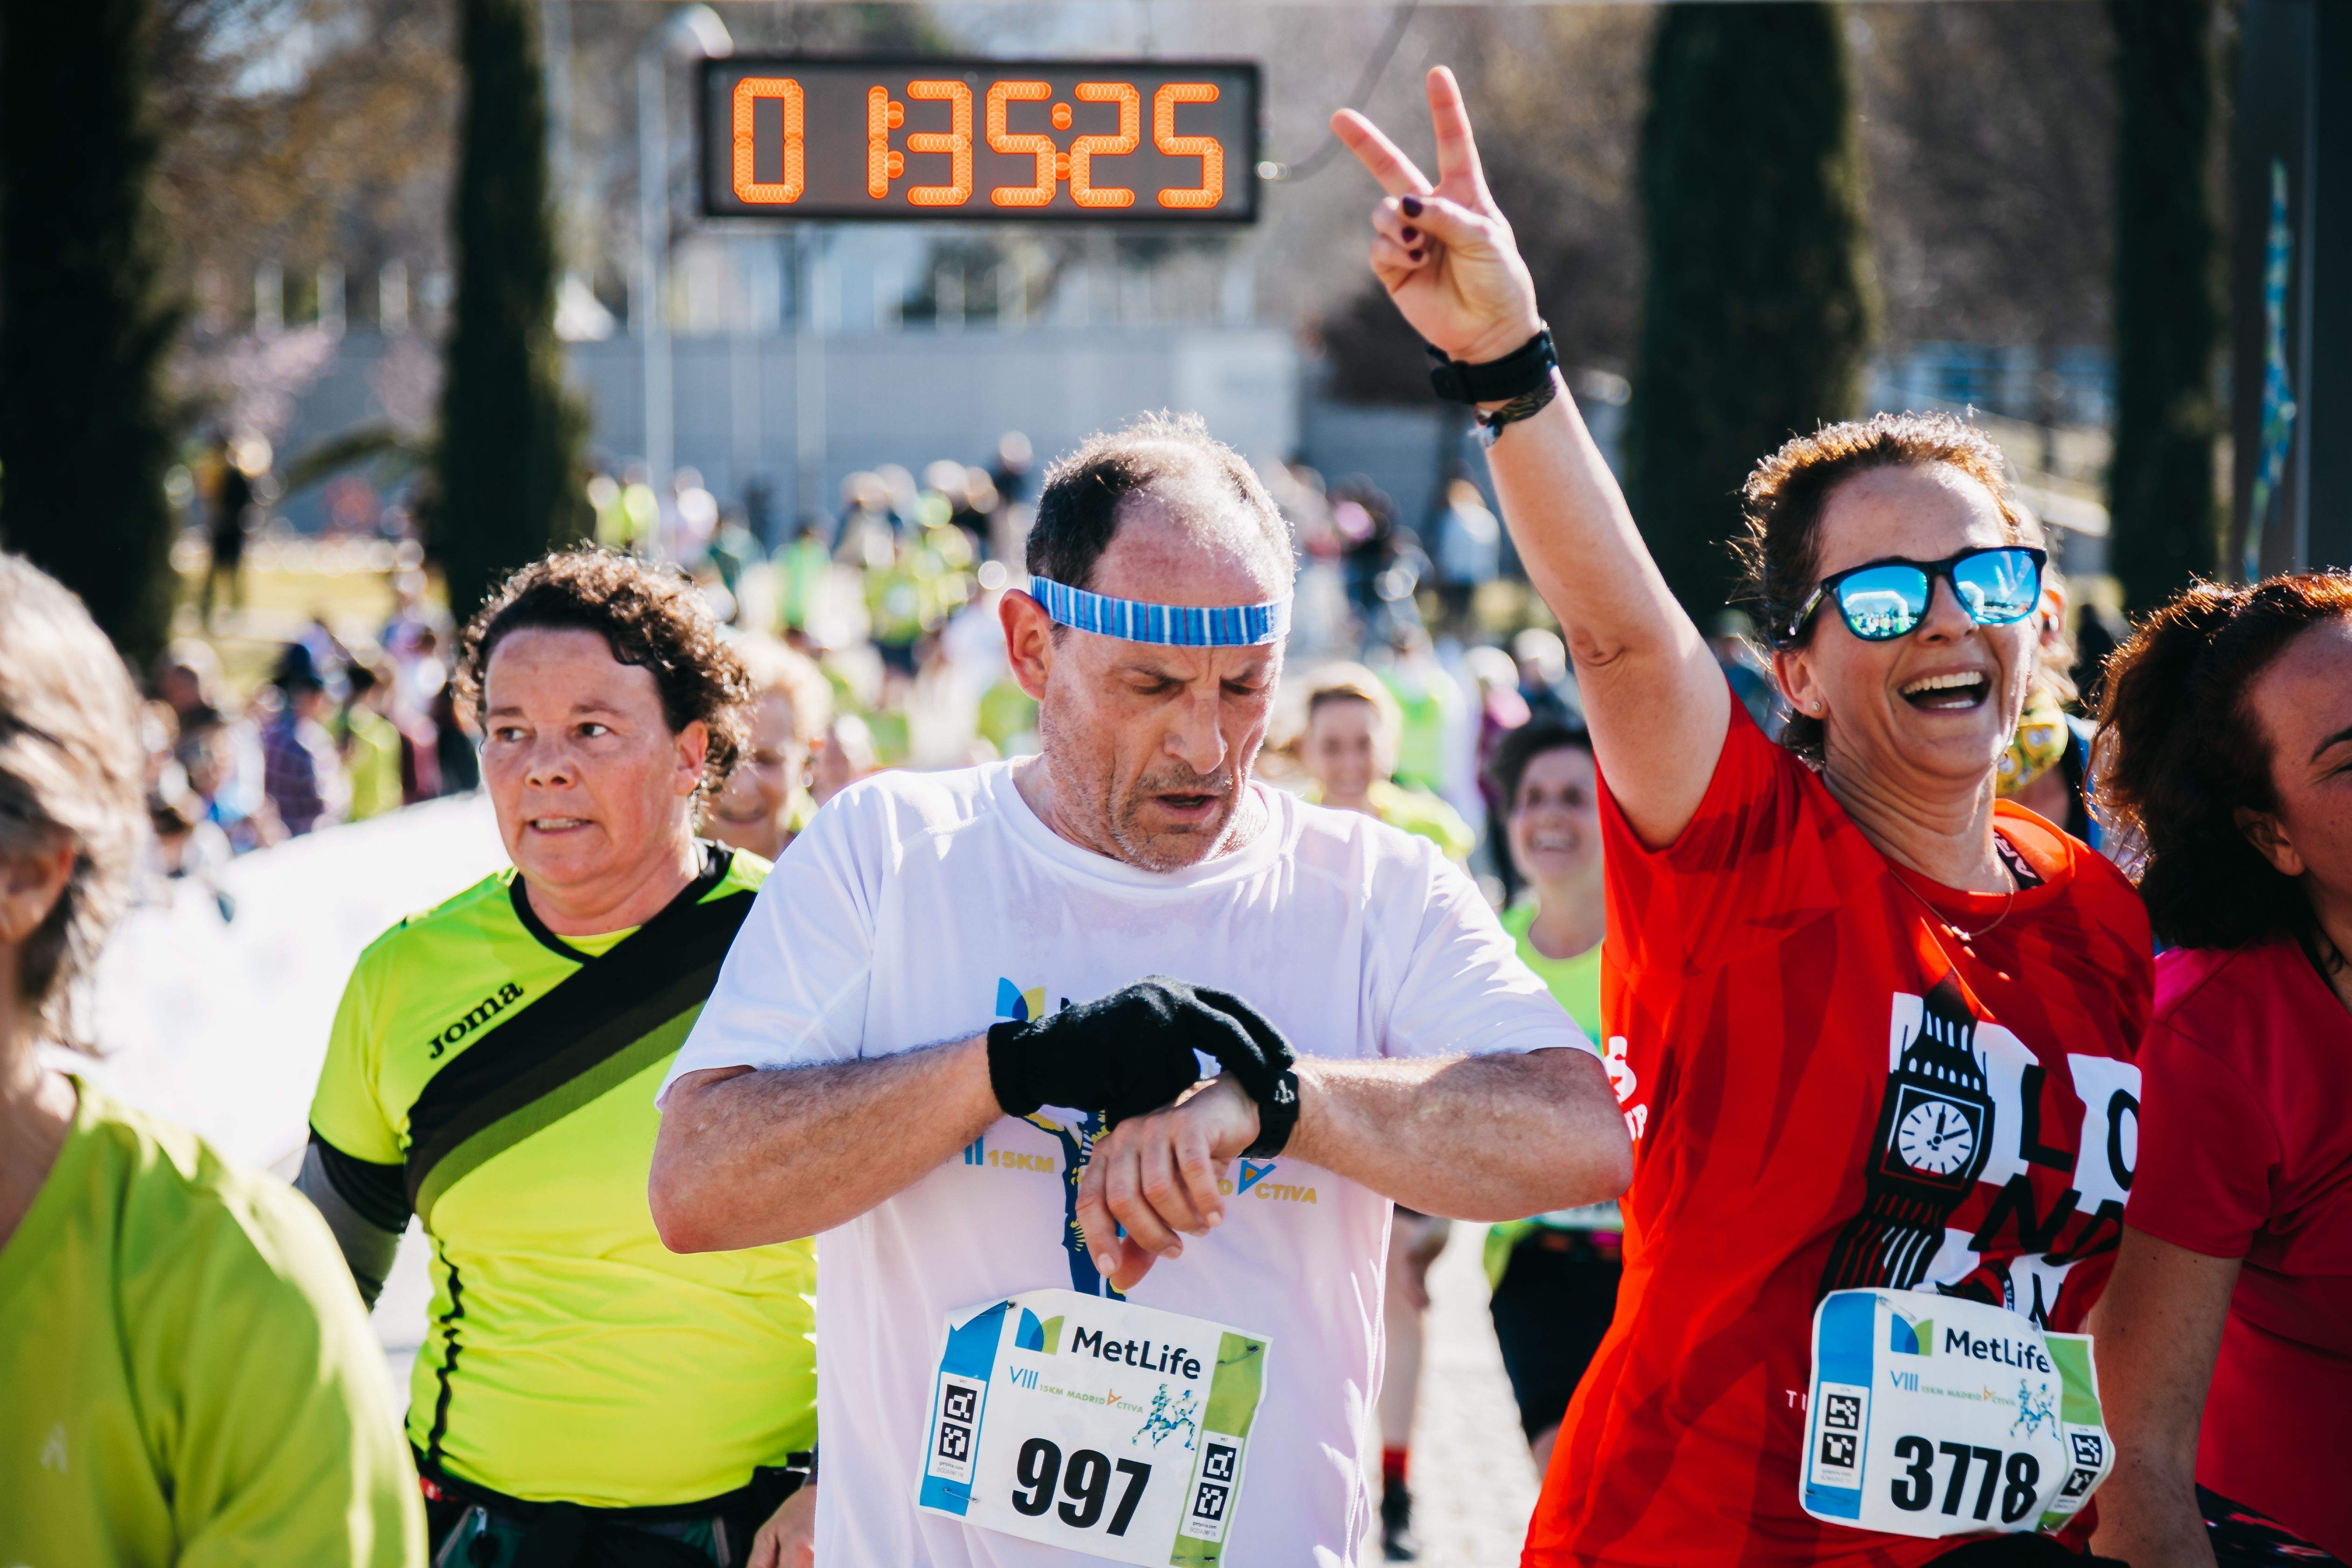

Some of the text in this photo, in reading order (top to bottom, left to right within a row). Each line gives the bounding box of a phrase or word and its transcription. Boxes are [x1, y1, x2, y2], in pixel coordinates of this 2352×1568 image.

[987, 1149, 1055, 1174] 15KM
[1071, 1326, 1201, 1380] MetLife
[1945, 1327, 2051, 1373] MetLife
[1009, 1365, 1039, 1390] VIII
[1039, 1384, 1064, 1396] 15KM
[1066, 1391, 1105, 1405] MADRID
[1890, 1370, 1918, 1393] VIII
[1012, 1437, 1152, 1537] 997
[1890, 1435, 2040, 1524] 3778
